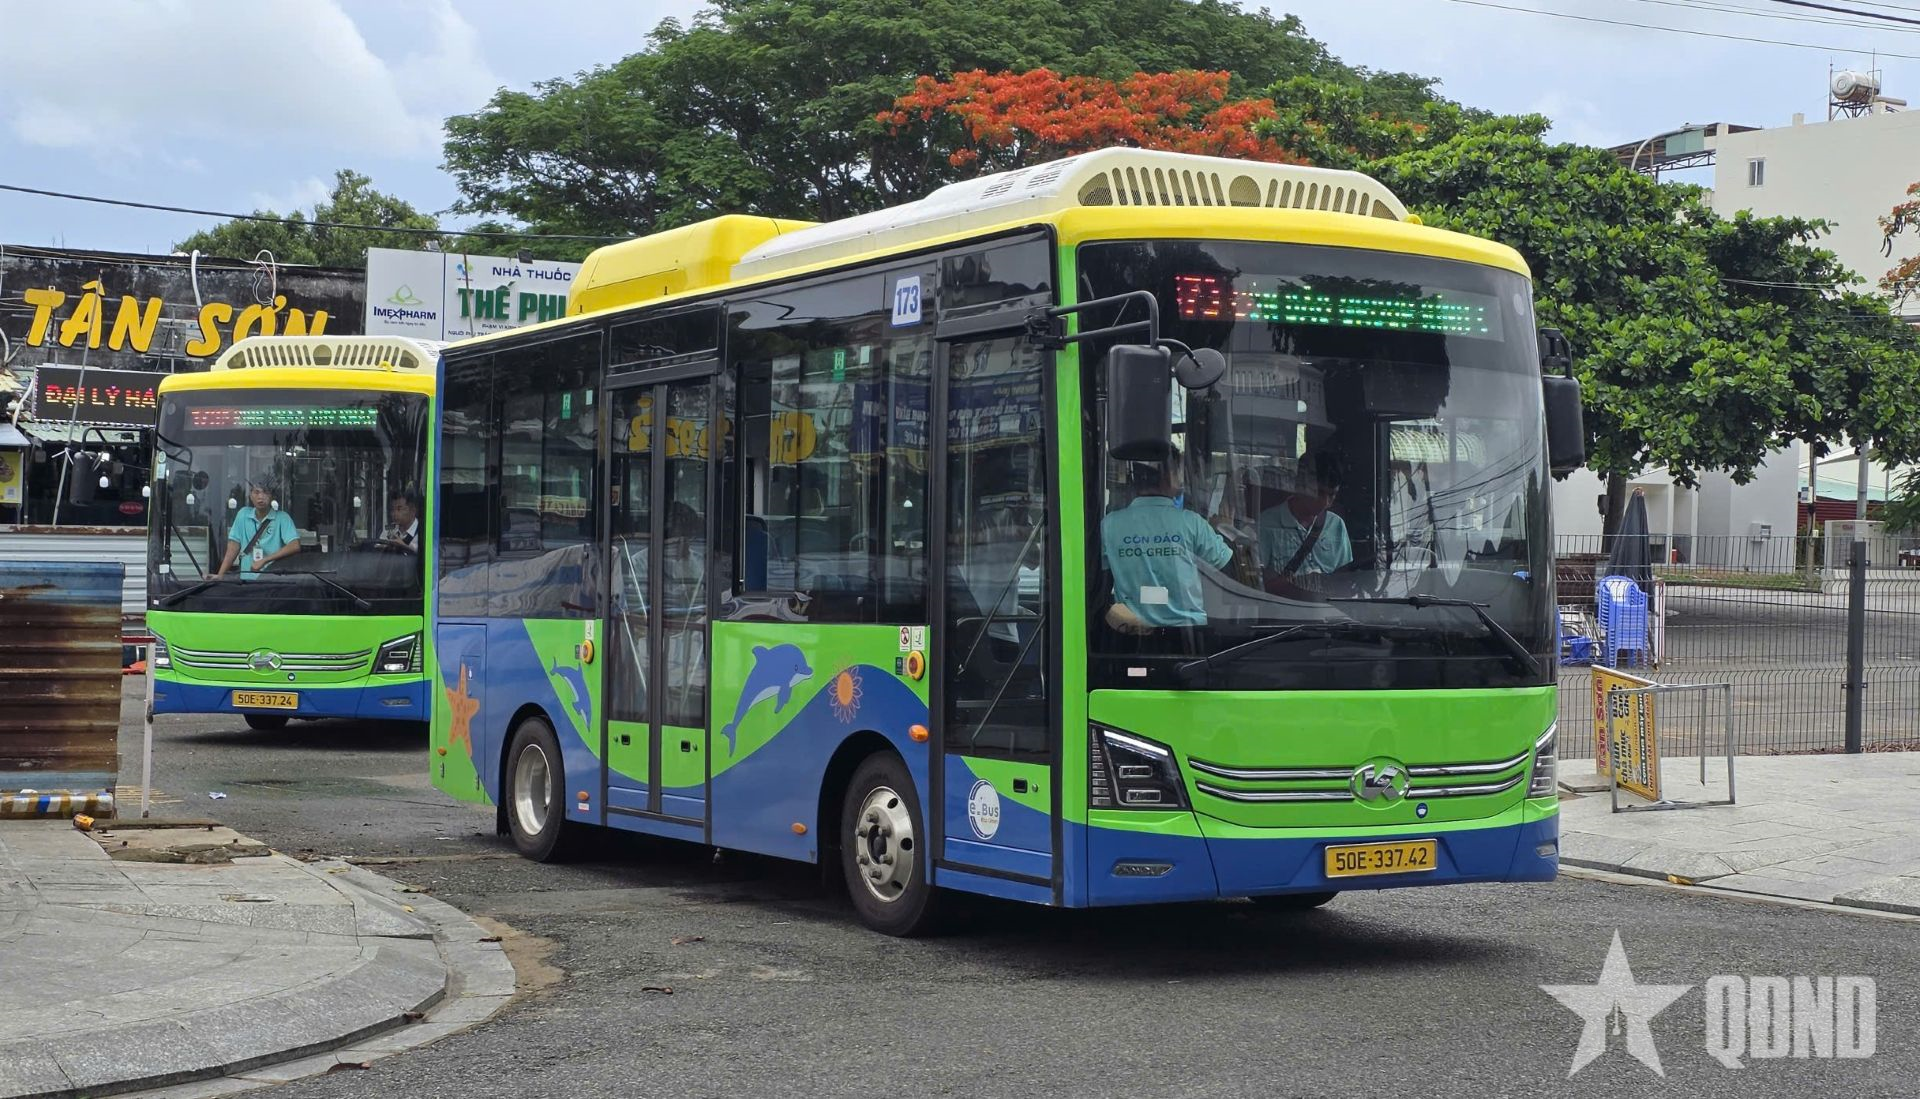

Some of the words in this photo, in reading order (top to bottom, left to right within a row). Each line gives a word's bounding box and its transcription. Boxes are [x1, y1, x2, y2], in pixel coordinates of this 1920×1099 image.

[492, 266, 521, 277] NHÀ
[527, 268, 571, 281] THUỐC
[373, 306, 437, 321] IMEXPHARM
[457, 281, 515, 319] THẾ
[896, 285, 918, 316] 173
[24, 280, 163, 353] TÂN
[186, 295, 329, 357] SƠN
[91, 385, 120, 406] LÝ
[238, 694, 292, 705] 50E-337.24
[1596, 678, 1604, 722] Sơn
[1598, 728, 1606, 768] Tân
[1336, 847, 1427, 871] 50E-337.42
